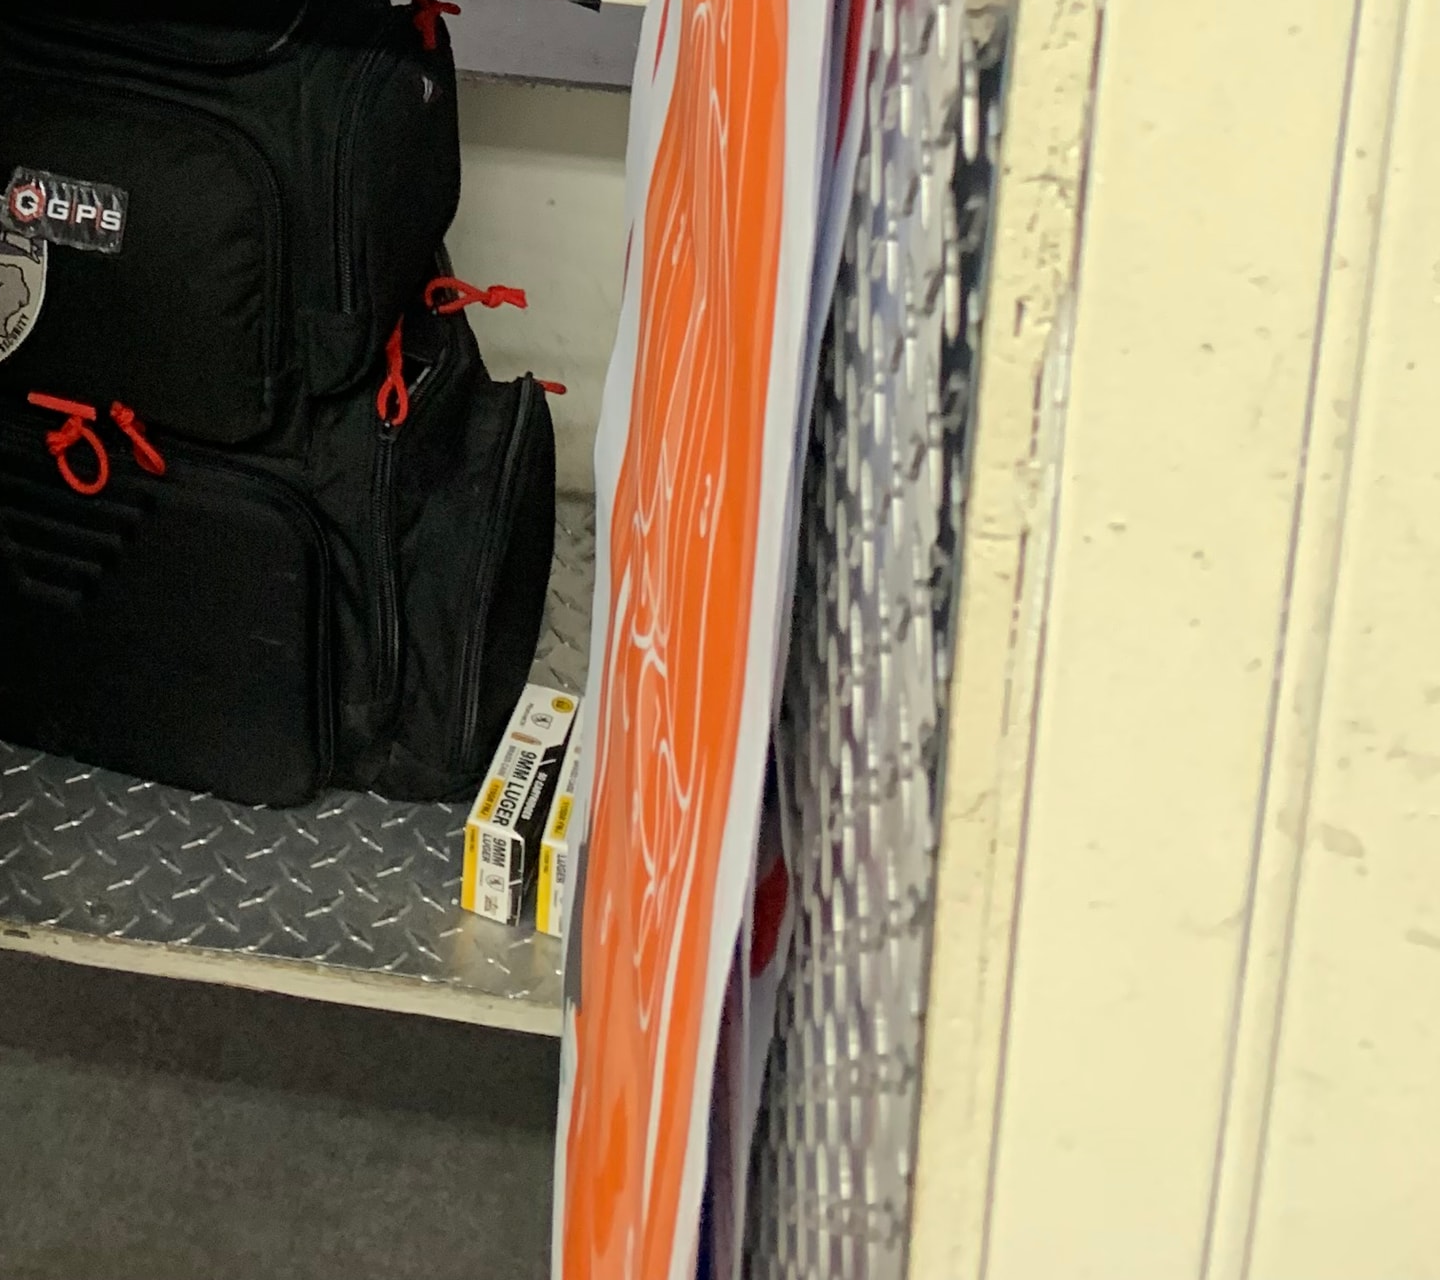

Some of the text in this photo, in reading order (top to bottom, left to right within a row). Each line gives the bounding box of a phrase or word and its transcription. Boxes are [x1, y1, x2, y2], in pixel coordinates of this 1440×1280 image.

[46, 198, 122, 232] GPS
[513, 750, 537, 781] 9MM
[492, 781, 524, 827] LUGER
[482, 833, 492, 863] LUGER
[491, 837, 507, 868] 9MM
